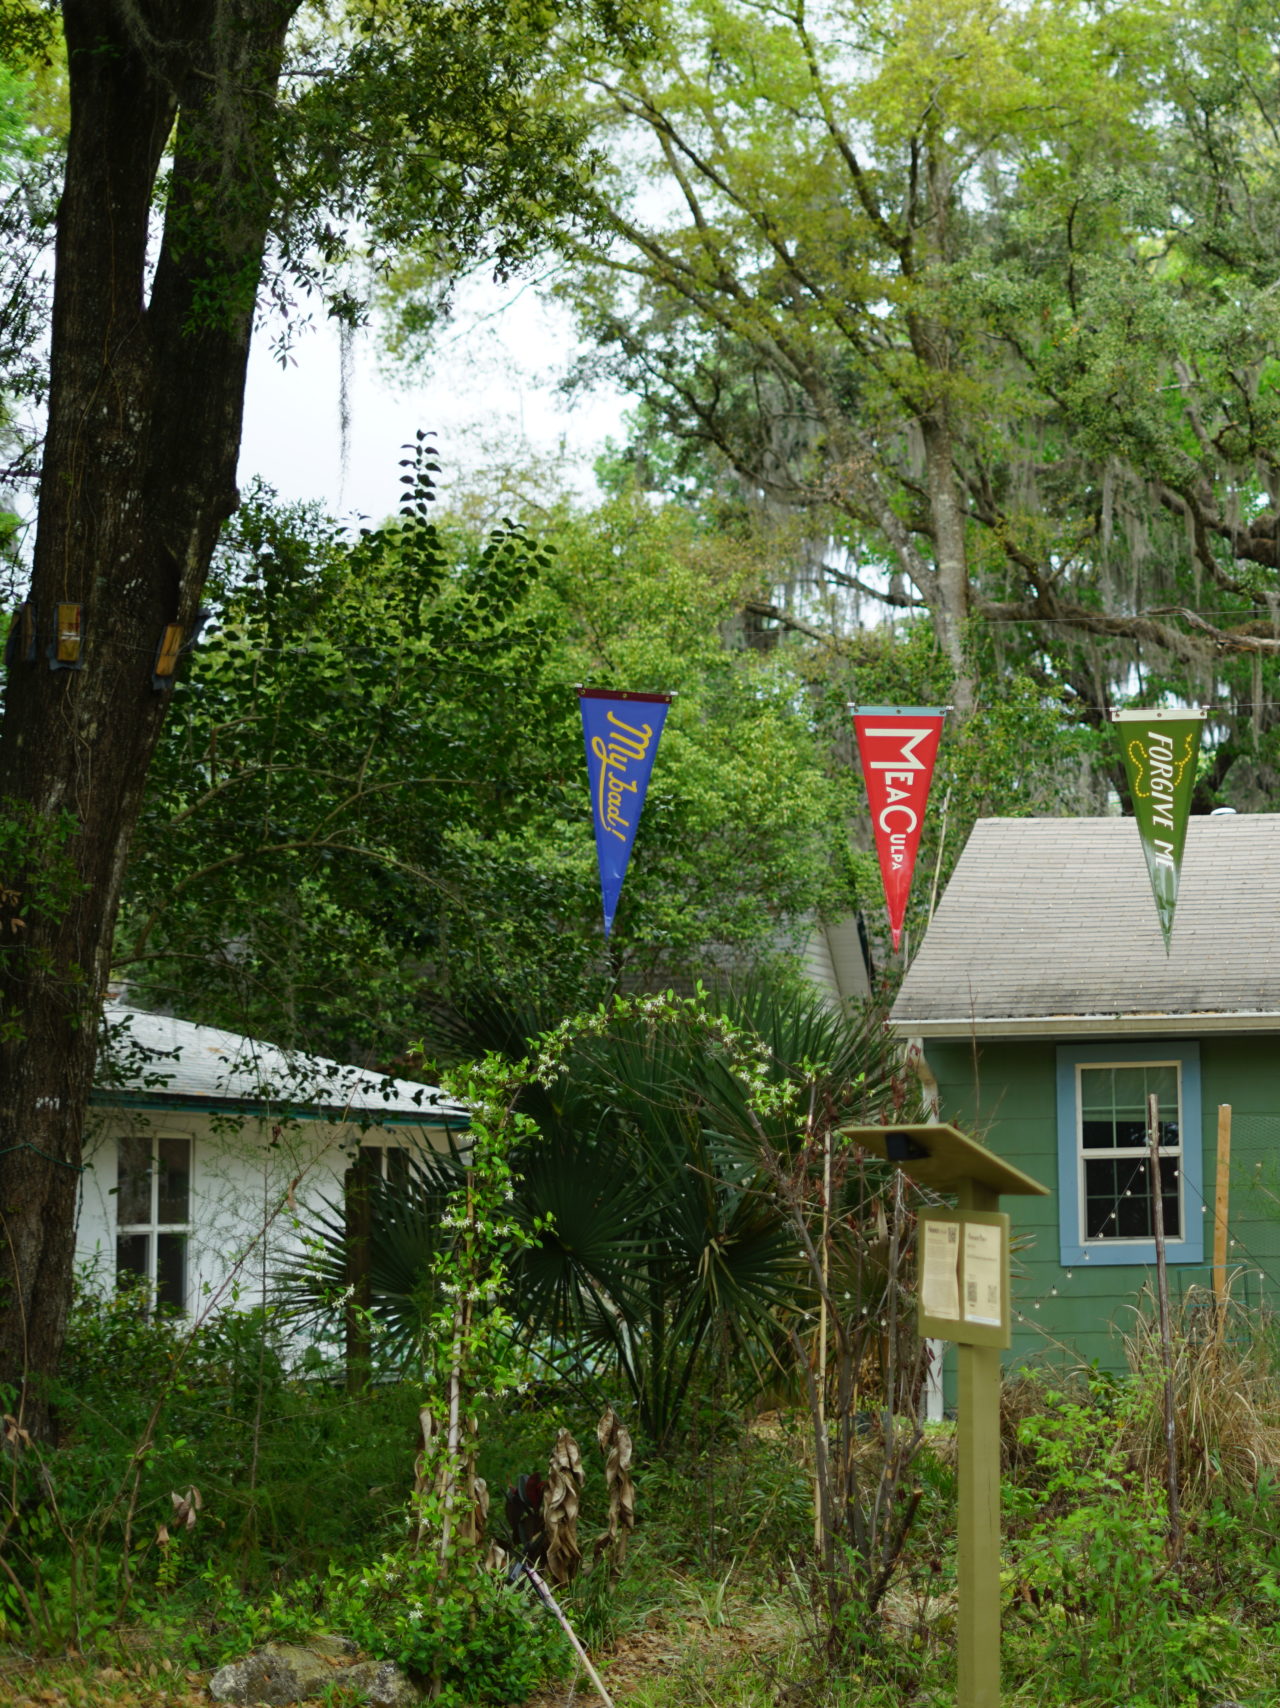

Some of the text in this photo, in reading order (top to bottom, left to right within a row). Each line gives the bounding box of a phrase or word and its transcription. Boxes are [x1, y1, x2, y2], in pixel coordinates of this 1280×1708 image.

[591, 710, 653, 843] My bad!
[1147, 731, 1175, 872] FORGIVE ME
